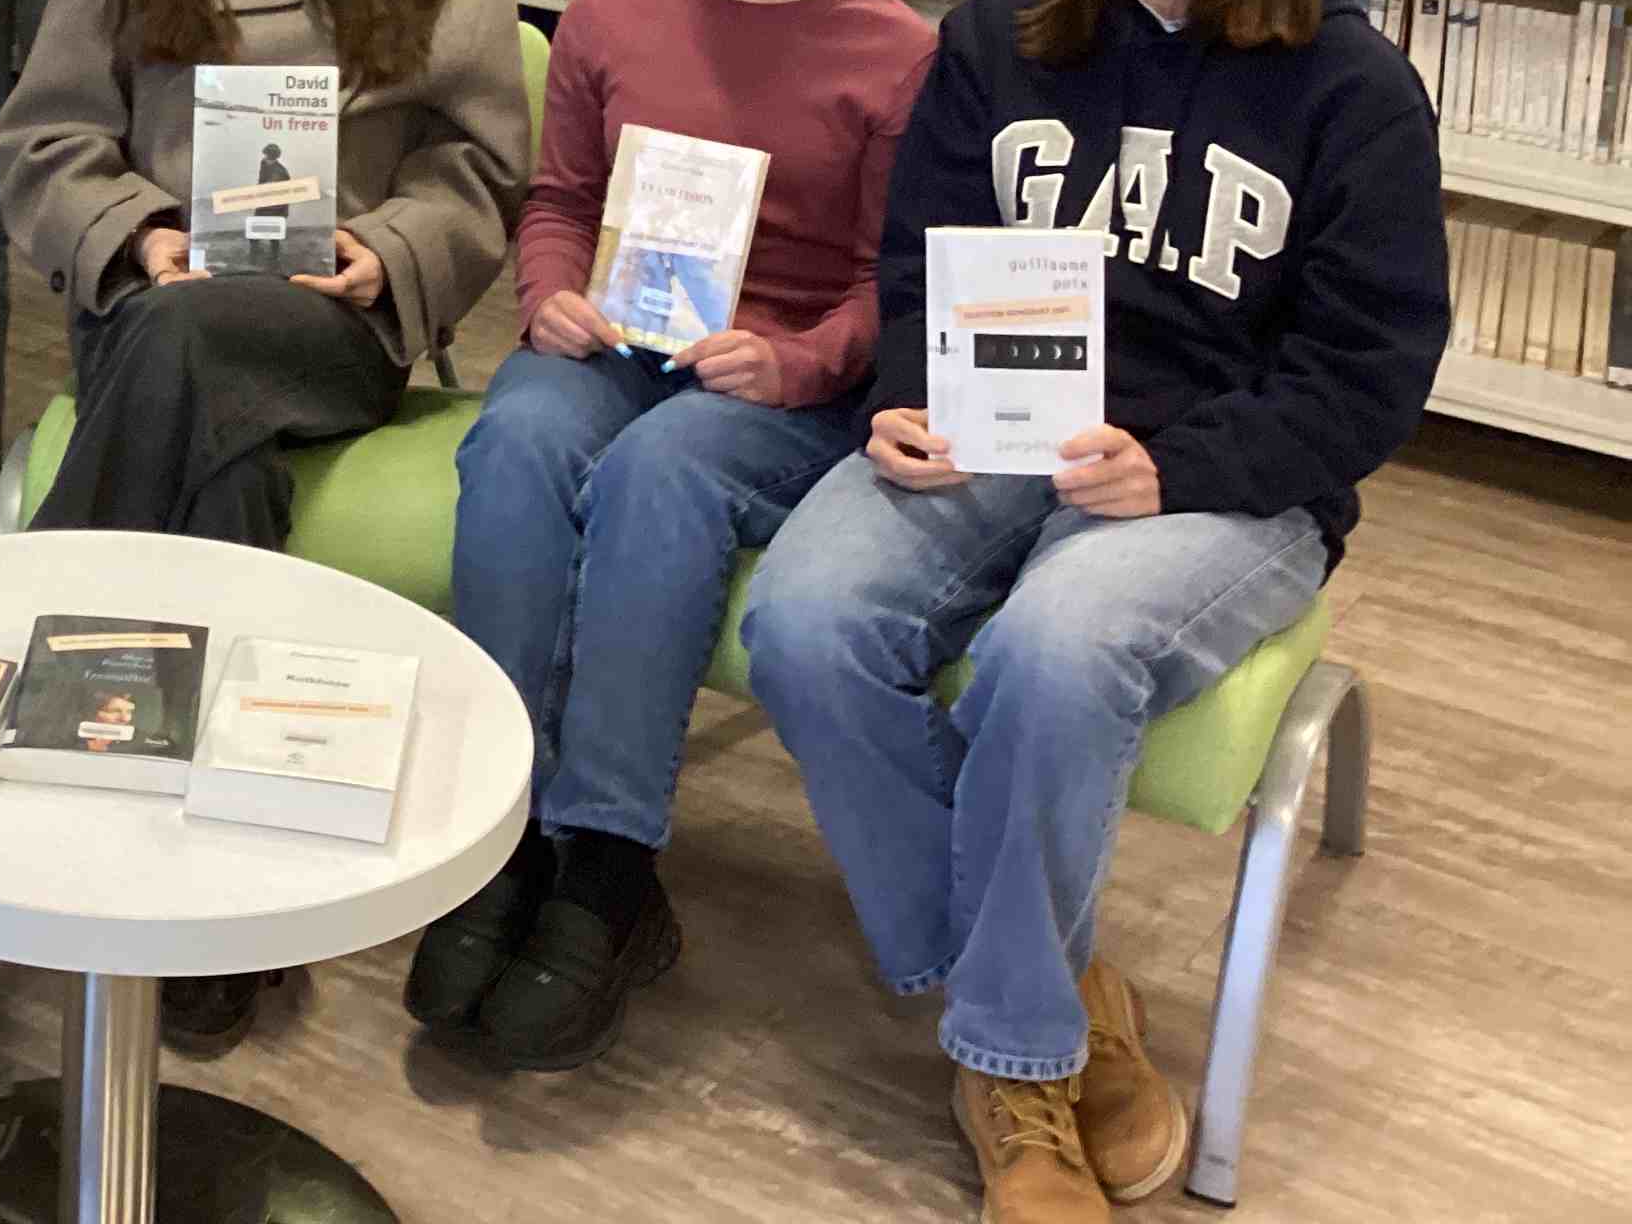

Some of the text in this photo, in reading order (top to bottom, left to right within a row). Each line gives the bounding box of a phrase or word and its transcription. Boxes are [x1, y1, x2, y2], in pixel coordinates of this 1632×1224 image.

[286, 75, 328, 90] David
[268, 92, 328, 107] Thomas
[263, 117, 282, 130] Un
